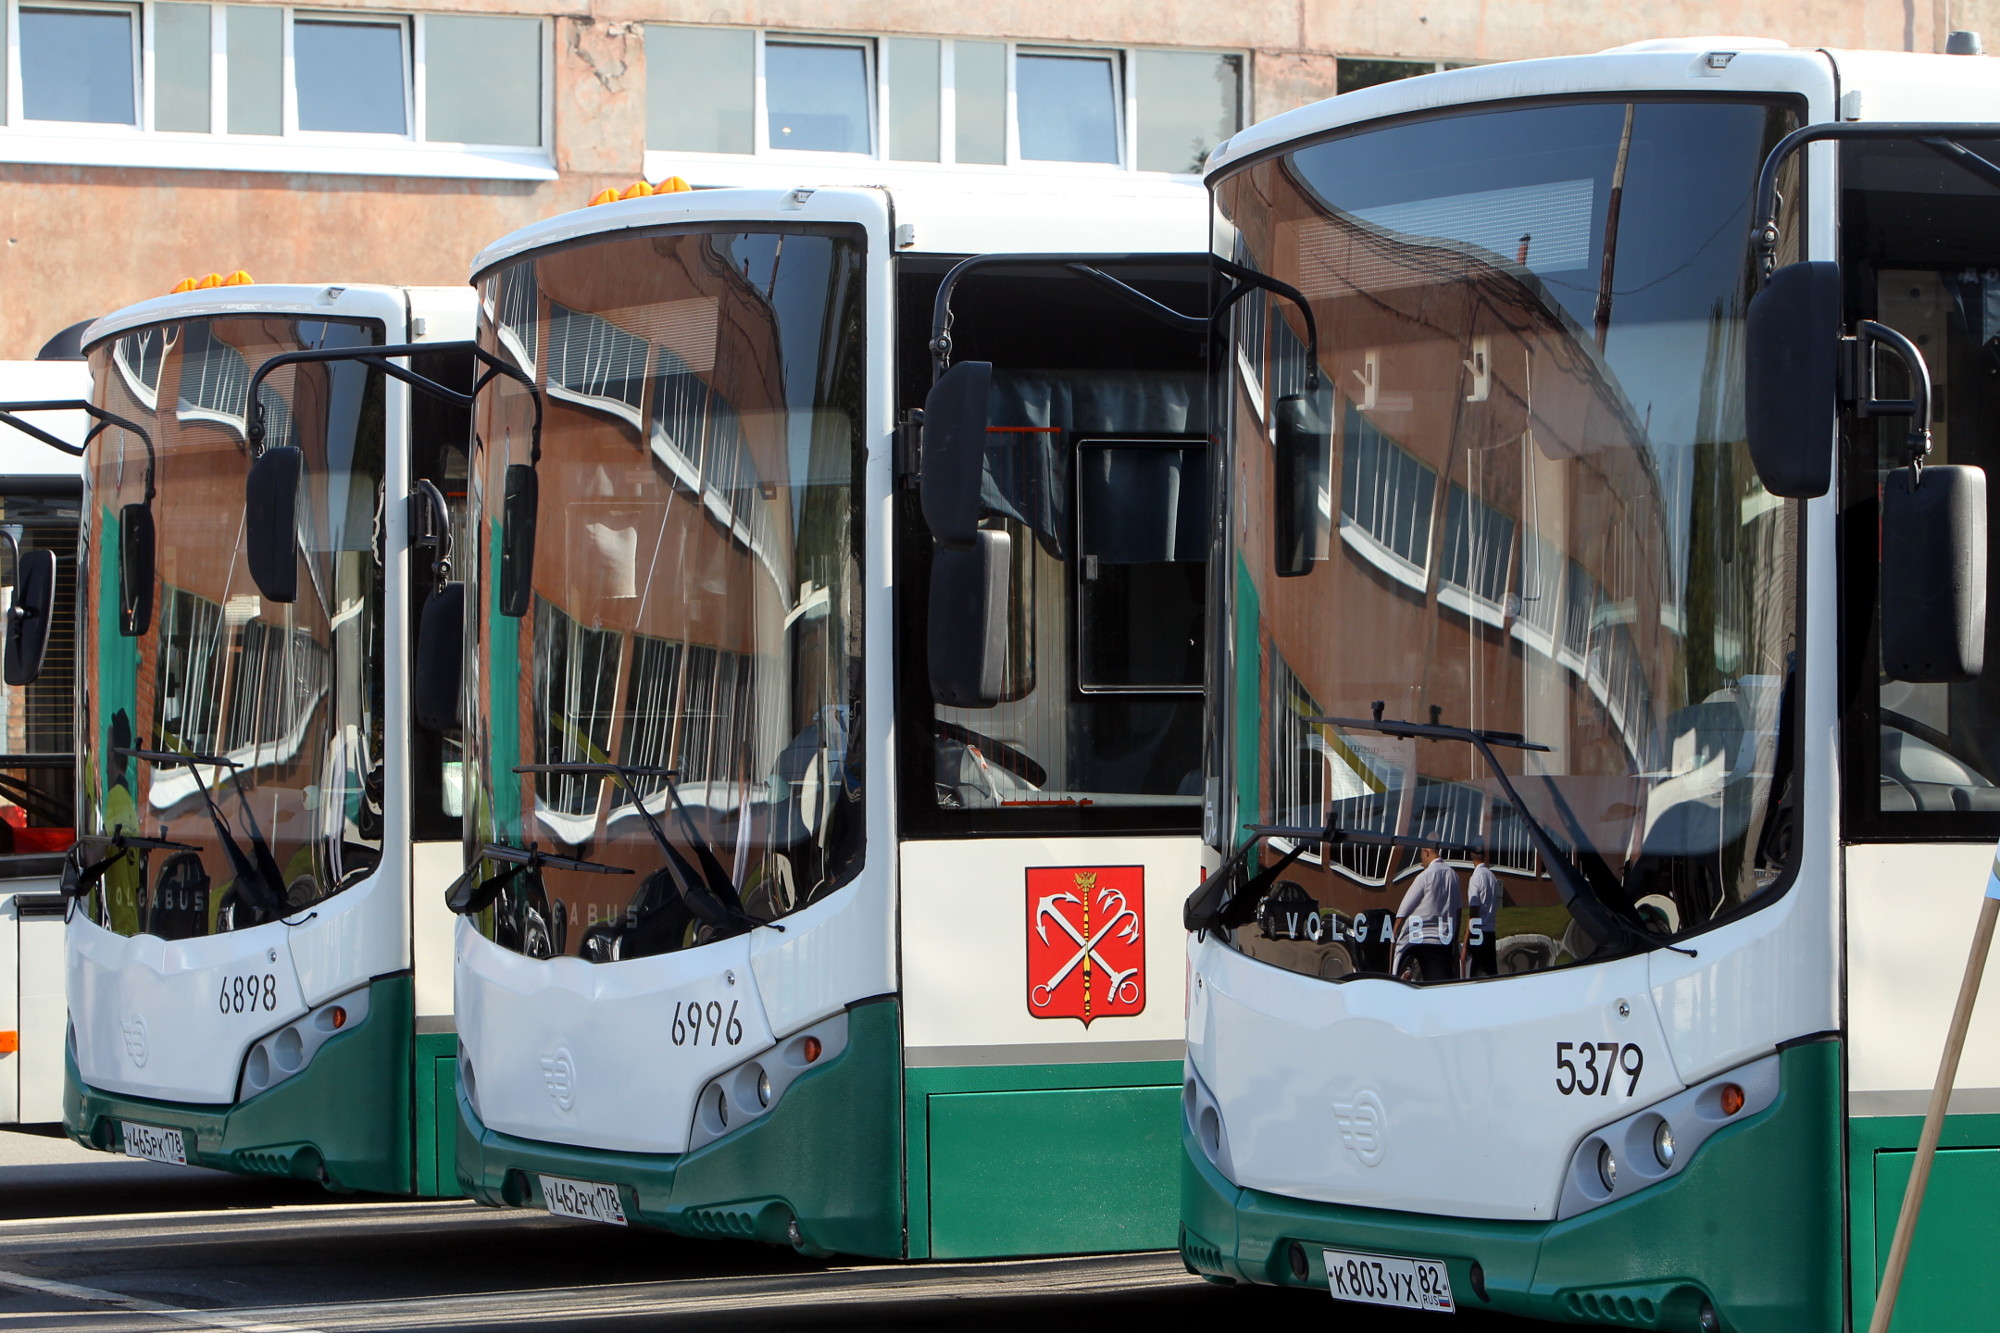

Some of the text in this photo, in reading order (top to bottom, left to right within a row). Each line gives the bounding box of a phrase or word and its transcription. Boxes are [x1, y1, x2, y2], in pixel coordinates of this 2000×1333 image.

[115, 886, 205, 912] OLGABUS
[521, 900, 639, 929] OGABUS
[1285, 911, 1485, 946] VOLGABUS
[219, 973, 277, 1015] 6898
[671, 999, 743, 1047] 6996
[1555, 1041, 1644, 1097] 5379
[597, 1186, 620, 1211] 178
[1418, 1265, 1442, 1295] 82
[1422, 1294, 1439, 1306] RUS
